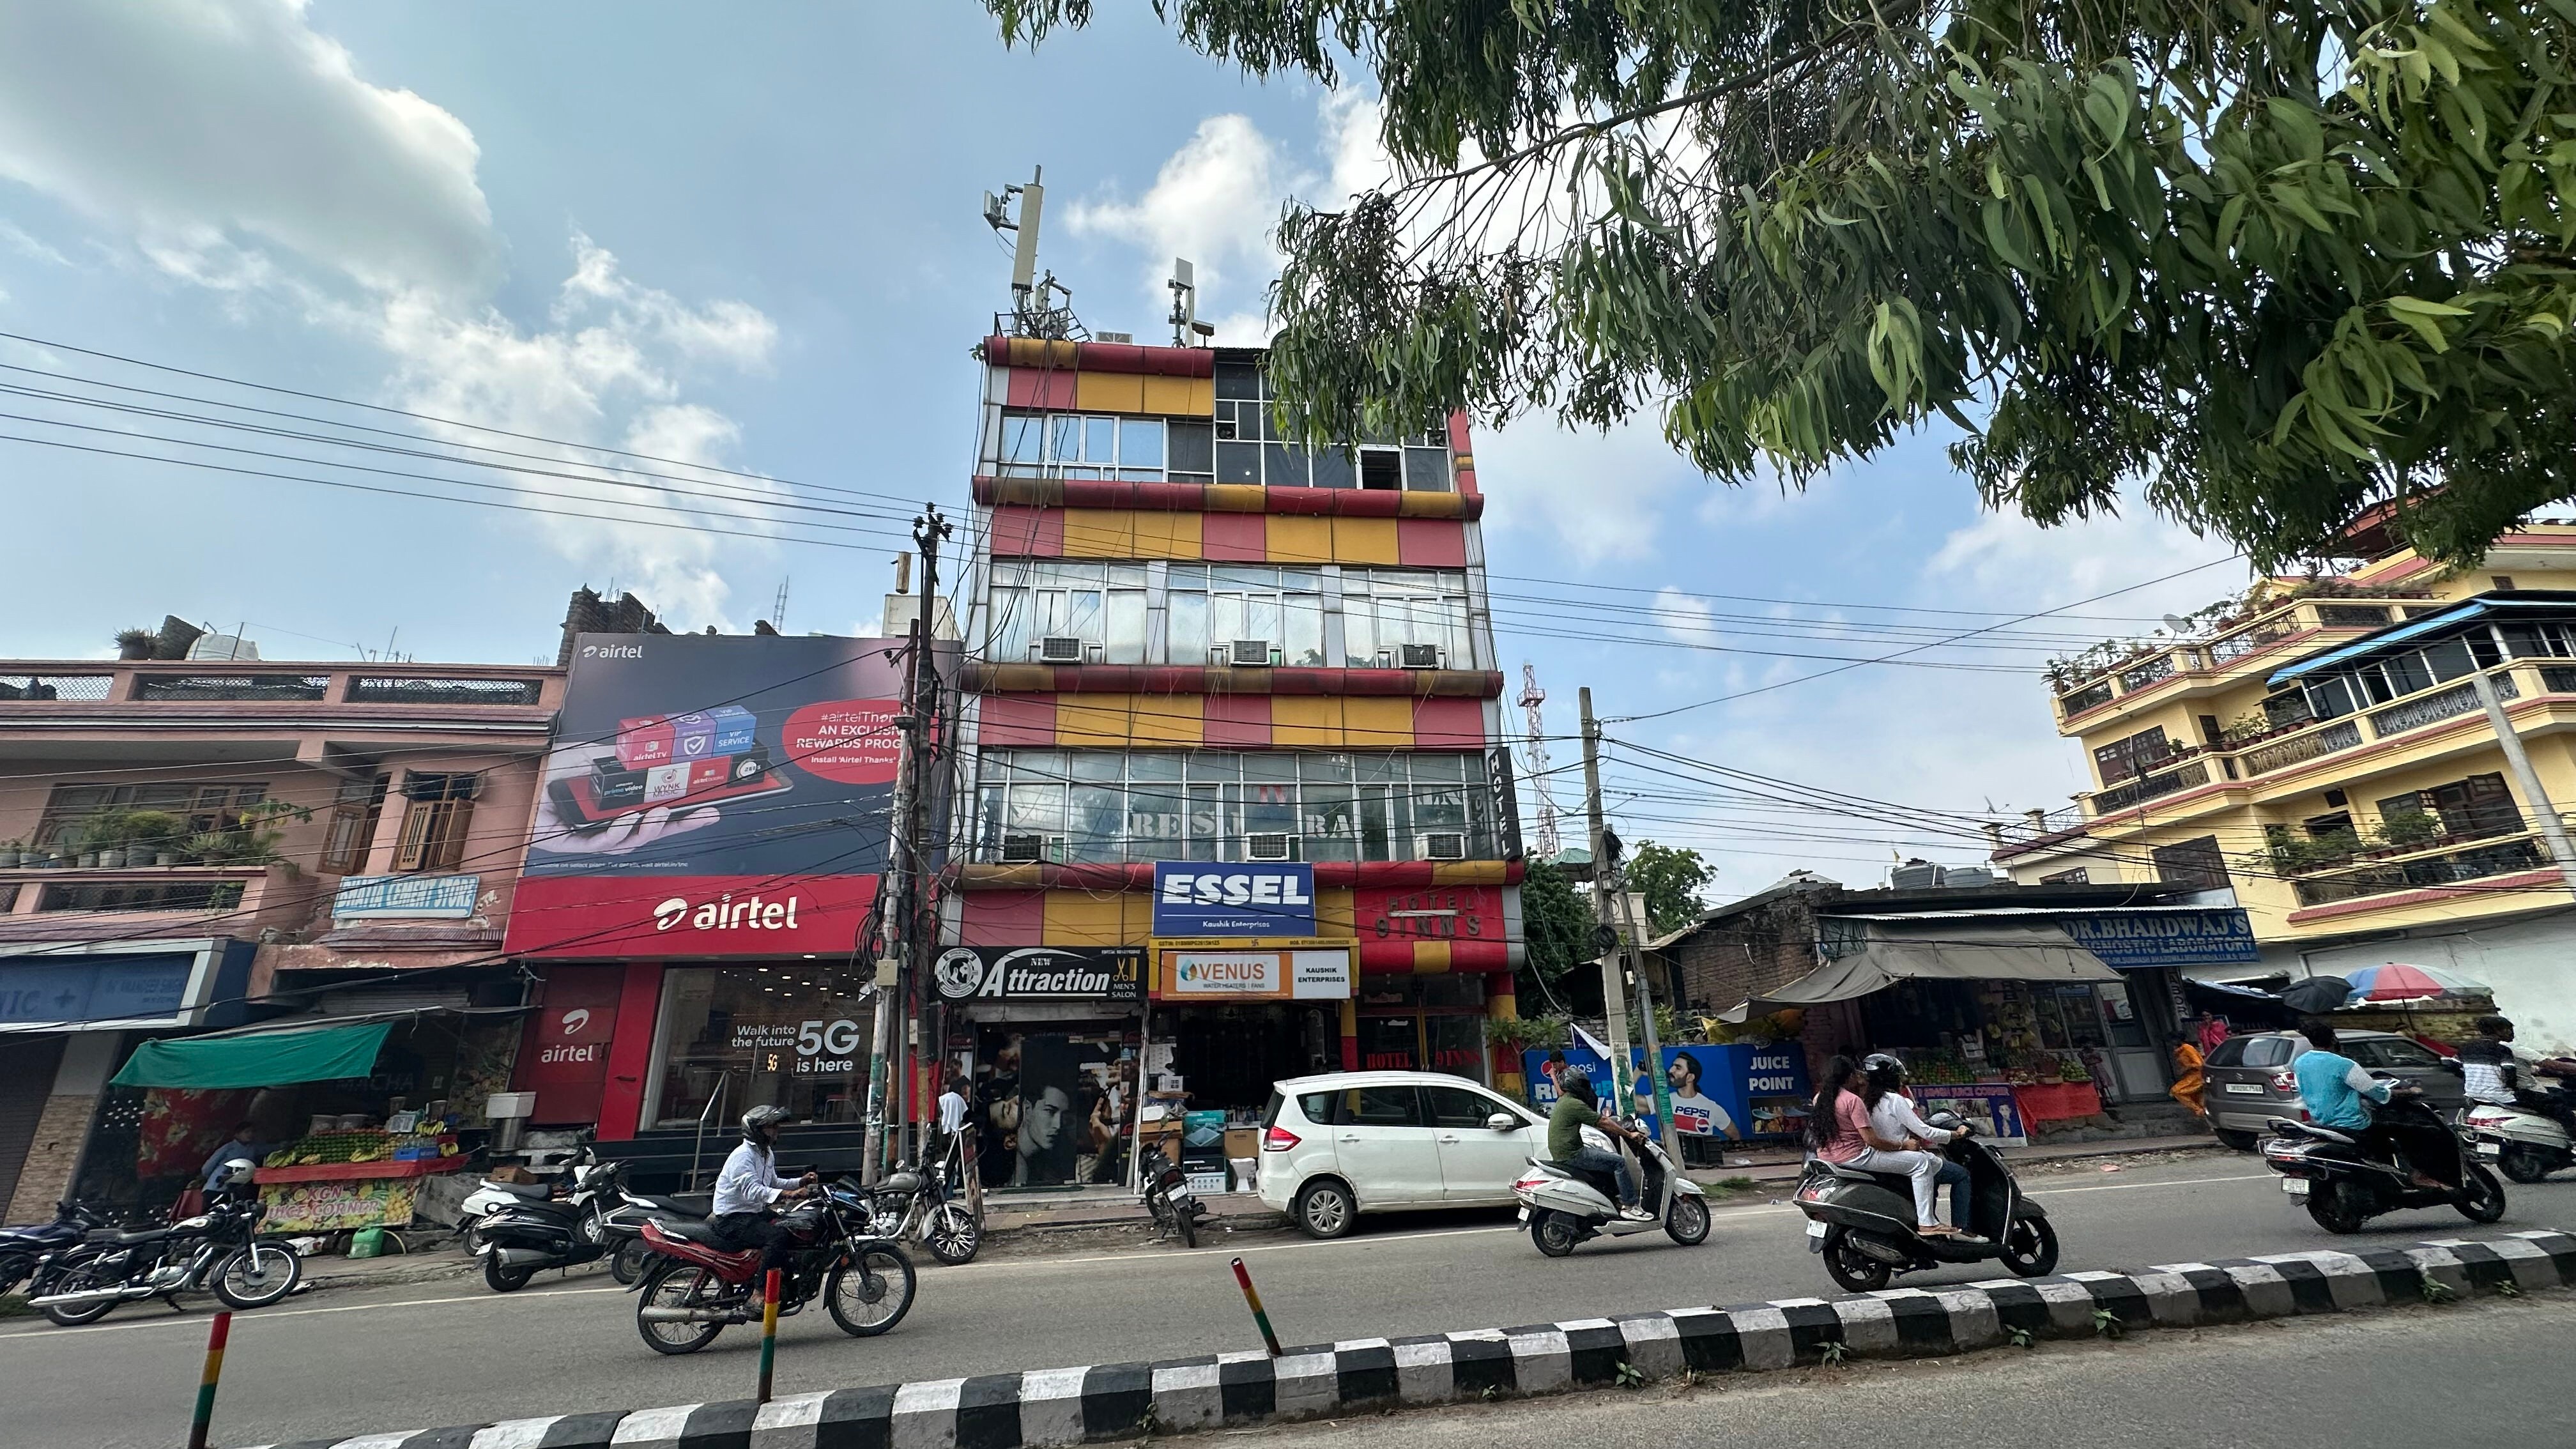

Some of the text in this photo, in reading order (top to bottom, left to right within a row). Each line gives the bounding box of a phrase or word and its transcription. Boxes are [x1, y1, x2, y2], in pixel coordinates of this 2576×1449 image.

[599, 644, 642, 658] airtel
[821, 711, 901, 723] #airtelThan
[818, 724, 901, 735] AN EXCLUSIV
[717, 736, 750, 747] SERVICE
[796, 737, 901, 749] REWARDS PROG
[654, 783, 680, 791] WYNK
[1489, 754, 1510, 856] HOTEL
[385, 879, 436, 908] CEMENT
[434, 877, 476, 907] STORE
[1162, 874, 1310, 905] ESSEL
[1388, 894, 1475, 910] HOTEL
[693, 894, 798, 930] airtel
[1231, 920, 1271, 929] Enterprises
[2160, 935, 2255, 954] LABORATORY
[1031, 957, 1052, 967] NEW
[977, 948, 1110, 997] Attraction
[1199, 963, 1265, 980] VENUS
[737, 1024, 796, 1036] Walk into
[795, 1019, 859, 1055] 5G
[732, 1036, 795, 1047] the future
[541, 1044, 593, 1063] airtel
[1367, 1052, 1413, 1069] HOTEL
[767, 1054, 778, 1071] 5G
[796, 1057, 854, 1073] is here
[1750, 1056, 1790, 1070] JUICE
[1749, 1077, 1794, 1091] POINT
[1675, 1105, 1710, 1119] PEPSI
[307, 1184, 344, 1201] KGN
